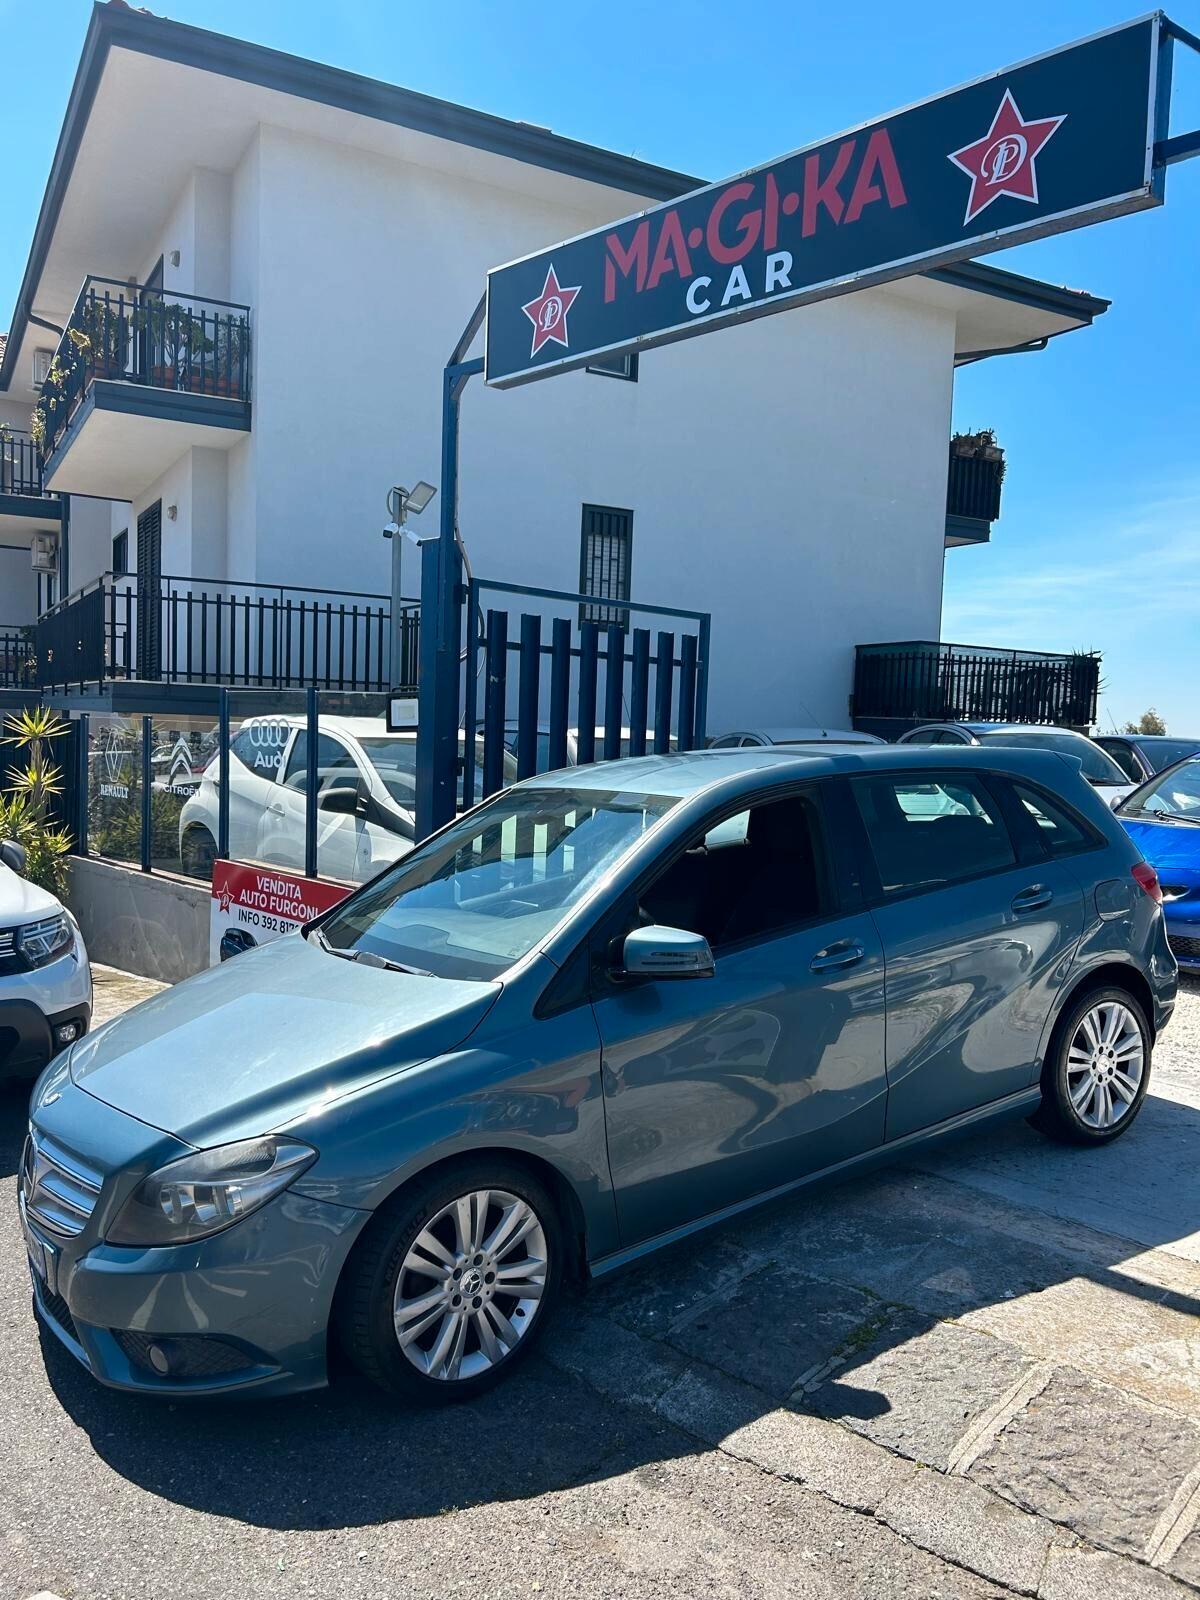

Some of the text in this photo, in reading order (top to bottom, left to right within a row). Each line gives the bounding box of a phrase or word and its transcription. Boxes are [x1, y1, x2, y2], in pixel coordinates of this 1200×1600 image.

[685, 250, 793, 314] CAR
[100, 783, 129, 799] RENAULT
[256, 875, 302, 900] VENDITA
[239, 888, 267, 908] AUTO
[269, 896, 319, 920] FURGONI
[238, 908, 299, 934] INFO 392 817
